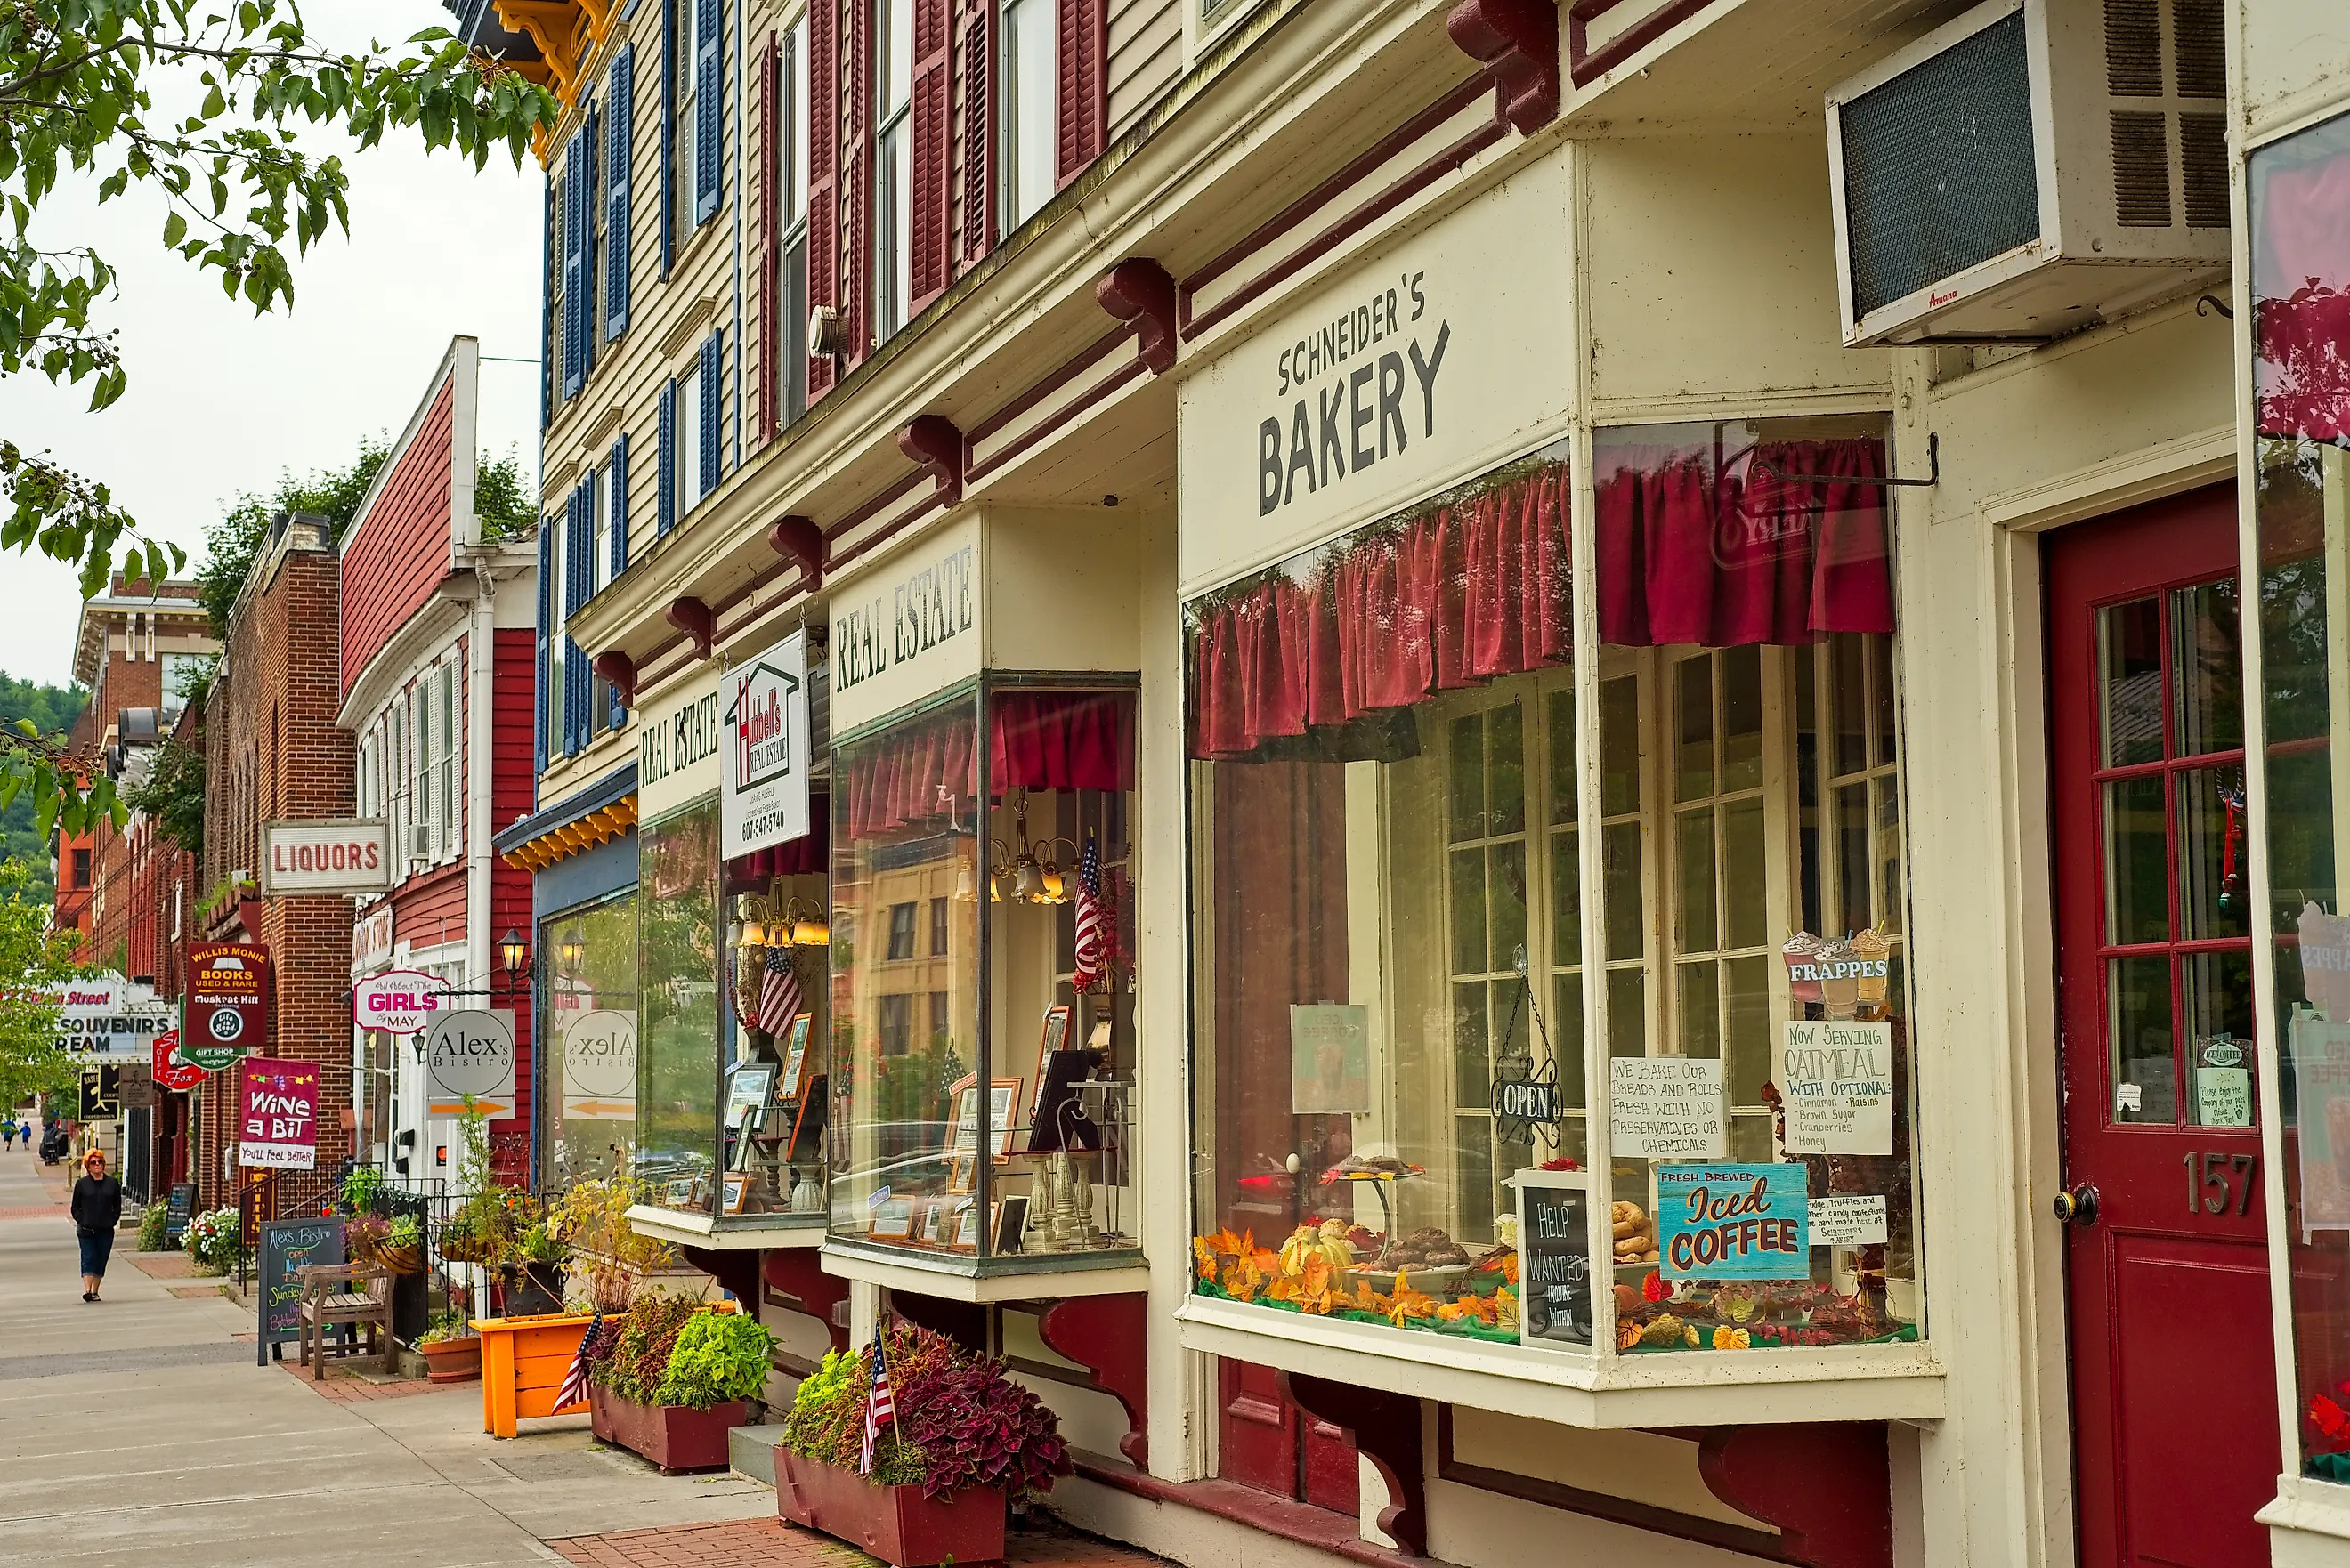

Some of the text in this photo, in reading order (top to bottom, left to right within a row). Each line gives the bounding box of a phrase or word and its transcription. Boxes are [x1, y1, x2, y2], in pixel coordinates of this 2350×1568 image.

[1929, 290, 1957, 308] Amana
[1278, 271, 1424, 396] SCHNEIDER'S
[1260, 319, 1450, 517] BAKERY
[836, 545, 973, 692] REAL ESTATE
[738, 674, 781, 787] Hubbell's
[641, 691, 717, 788] REAL ESTATE
[750, 737, 786, 773] REAL ESTATE
[742, 810, 784, 841] 607-547-5740
[274, 841, 378, 871] LIQUORS
[192, 948, 266, 964] WILLIS MONIE
[201, 970, 254, 979] BOOKS
[1789, 960, 1888, 982] FRAPPES
[375, 981, 432, 990] All About The
[68, 991, 110, 1005] Street
[195, 995, 239, 1004] Muskrat
[368, 992, 438, 1011] GIRLS
[60, 1017, 169, 1033] SOUVENIRS
[219, 1014, 233, 1022] Life
[376, 1013, 417, 1027] By MAY
[434, 1031, 508, 1055] Alex's
[1789, 1024, 1882, 1045] NOW SERVING
[54, 1036, 110, 1052] REAM
[434, 1056, 508, 1067] Bistro
[2206, 1050, 2241, 1060] ICED COFFEE
[1612, 1060, 1707, 1079] WE BAKE OUR
[1785, 1049, 1886, 1080] OATMEAL
[165, 1071, 193, 1086] Fox
[1660, 1084, 1684, 1096] AND
[1688, 1082, 1722, 1096] ROLLS
[1787, 1079, 1892, 1096] WITH OPTIONAL:
[2200, 1086, 2241, 1097] Please enjoy the
[251, 1091, 310, 1116] WiNe
[1503, 1084, 1548, 1118] OPEN
[1612, 1098, 1714, 1116] FRESH WITH NO
[1799, 1097, 1879, 1108] Cinnamon Raisins
[2219, 1098, 2224, 1106] of
[2235, 1095, 2245, 1104] pets
[1799, 1109, 1856, 1123] Brown Sugar
[246, 1117, 312, 1139] a BiT
[1612, 1119, 1719, 1136] PRESERVATIVES OR
[1799, 1122, 1853, 1133] Cranberries
[1642, 1139, 1707, 1152] CHEMICALS
[1798, 1135, 1827, 1152] Honey
[1661, 1172, 1754, 1182] FRESH BREWED
[2184, 1152, 2254, 1216] 157
[1685, 1176, 1772, 1224] Iced
[1829, 1199, 1860, 1208] Truffles
[1862, 1197, 1875, 1205] and
[1537, 1202, 1569, 1238] HELP
[1828, 1210, 1849, 1218] candy
[1875, 1216, 1883, 1224] at
[269, 1228, 330, 1249] Alex's Bistro
[1668, 1217, 1800, 1272] COFFEE
[288, 1249, 309, 1259] open
[1528, 1249, 1584, 1282] WANTED
[1547, 1284, 1572, 1303] INQUIRE
[1548, 1307, 1572, 1327] WITHIN
